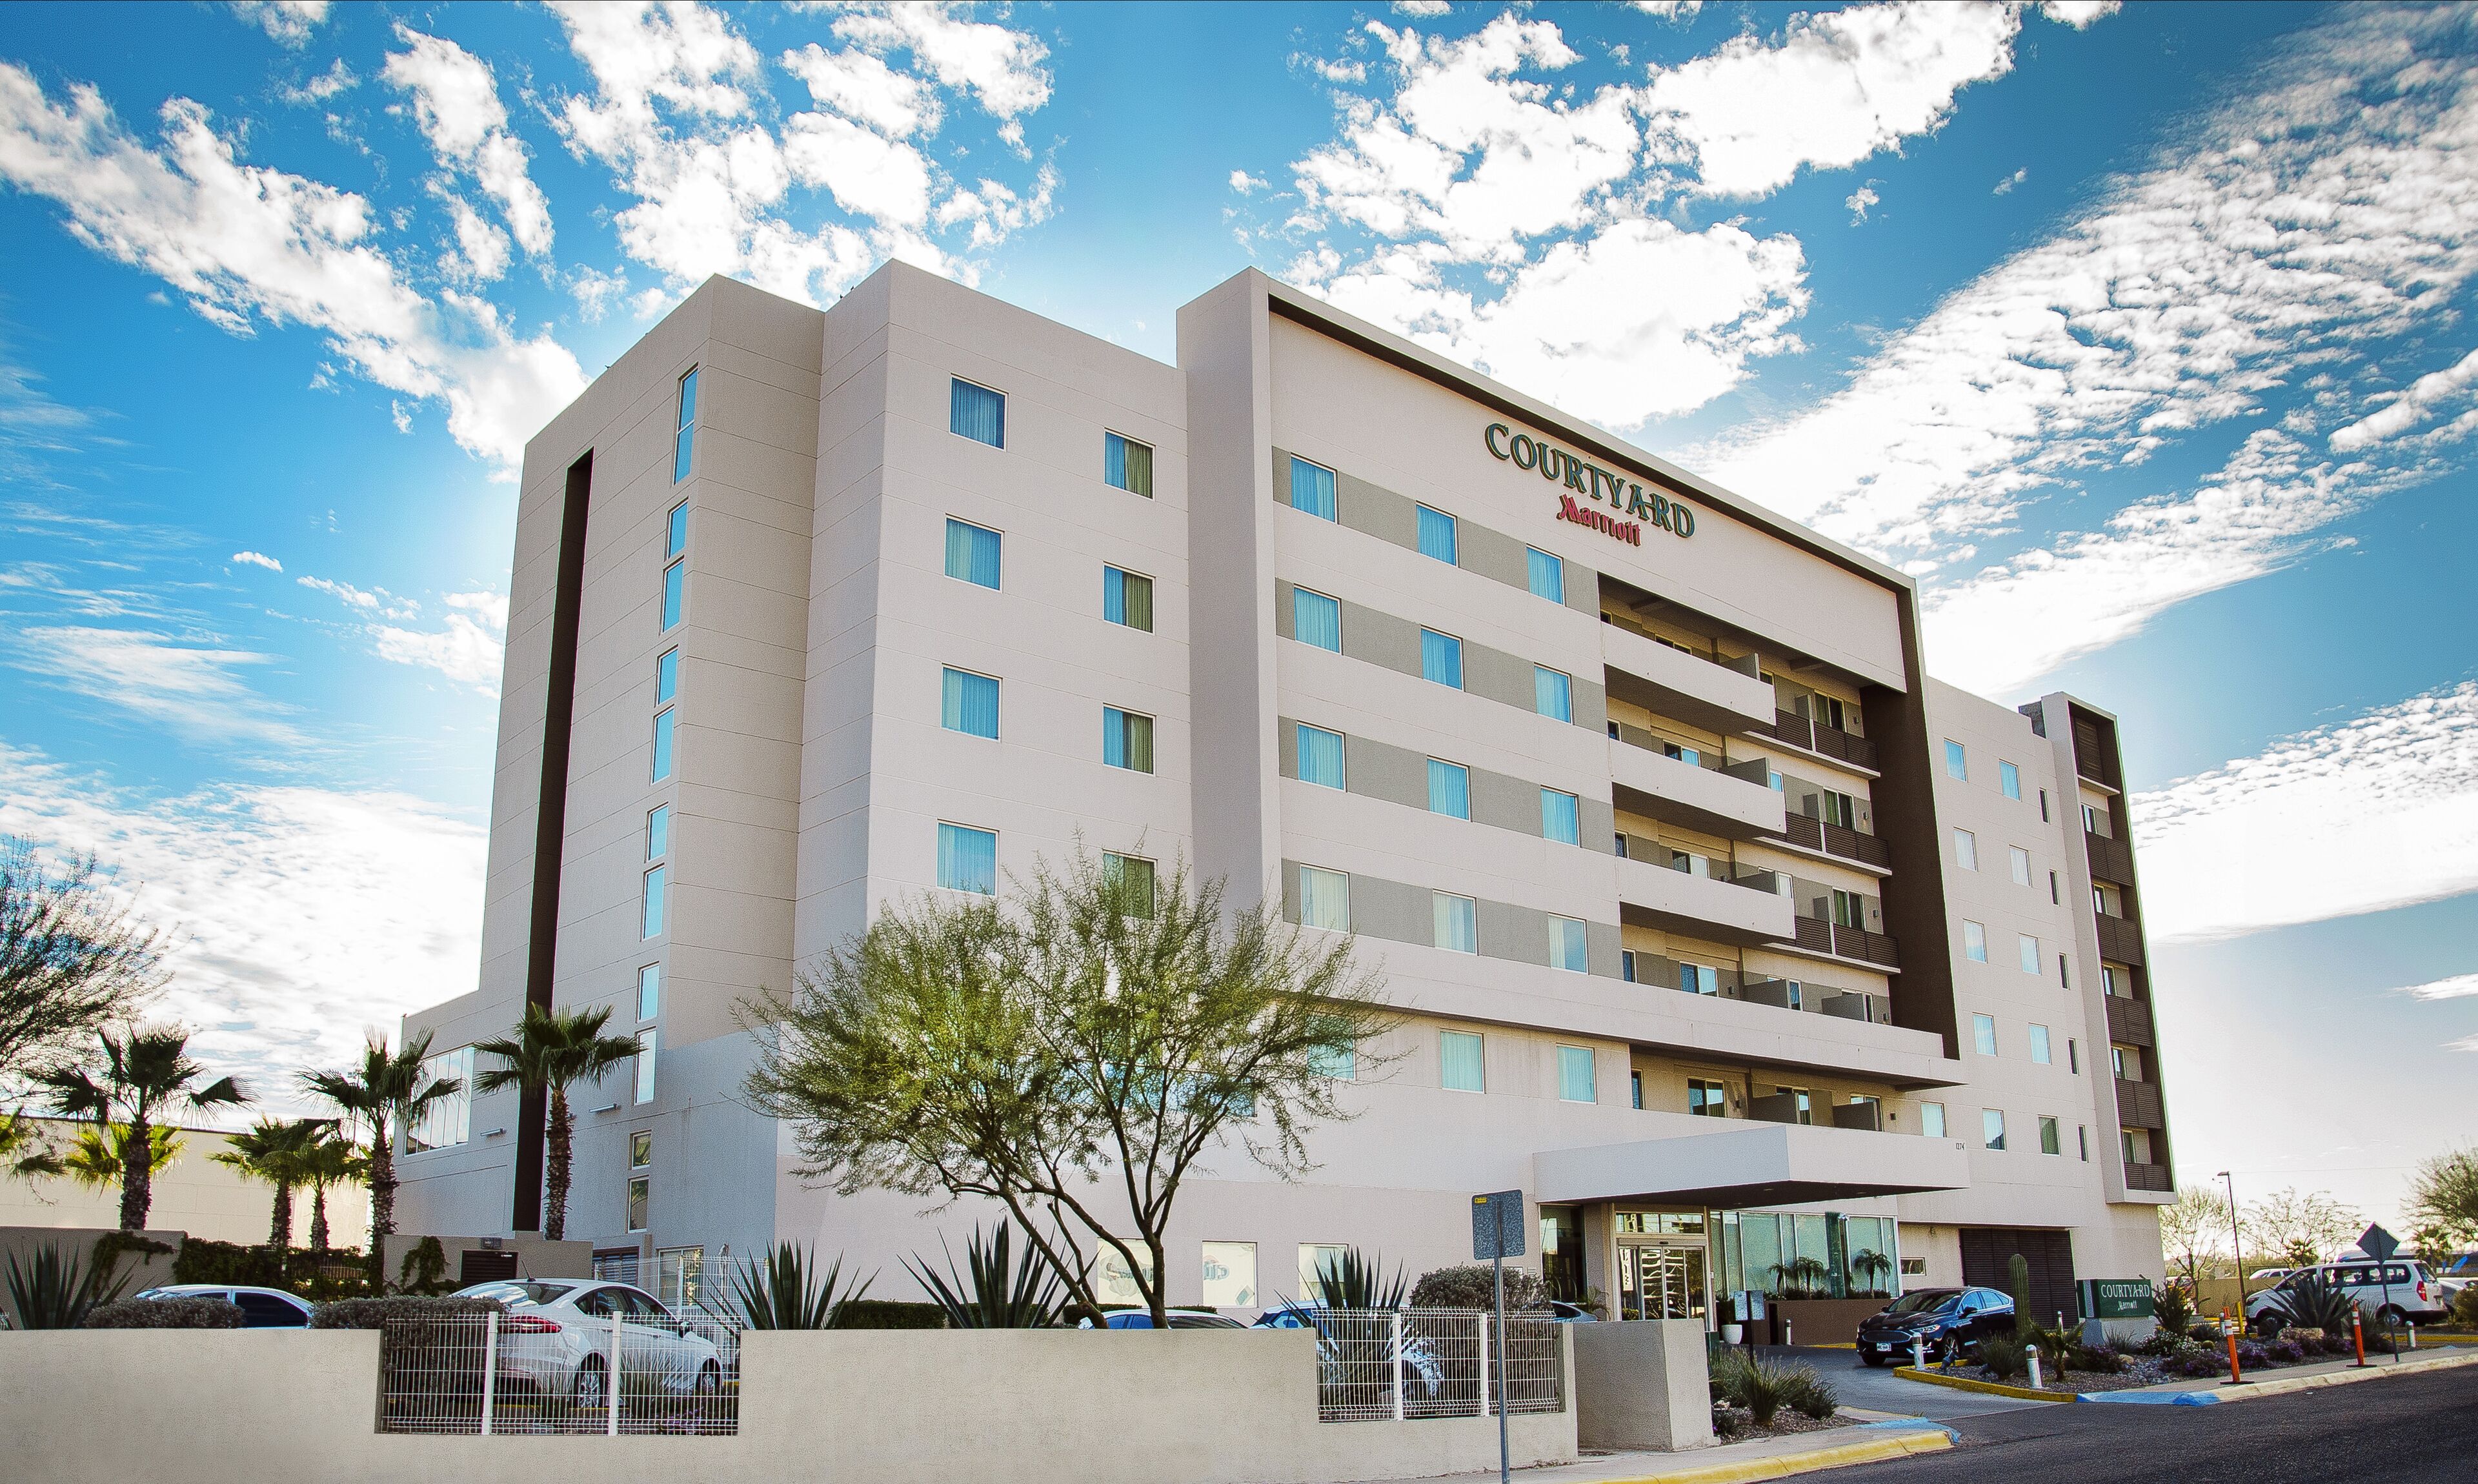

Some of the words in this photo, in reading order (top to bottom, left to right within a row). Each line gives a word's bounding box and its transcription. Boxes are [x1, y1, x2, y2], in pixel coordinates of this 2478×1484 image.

[1485, 423, 1695, 537] COURTYARD
[1556, 494, 1641, 546] Marriott
[2101, 1285, 2150, 1298] COURTYARD
[2118, 1299, 2137, 1310] Marriott
